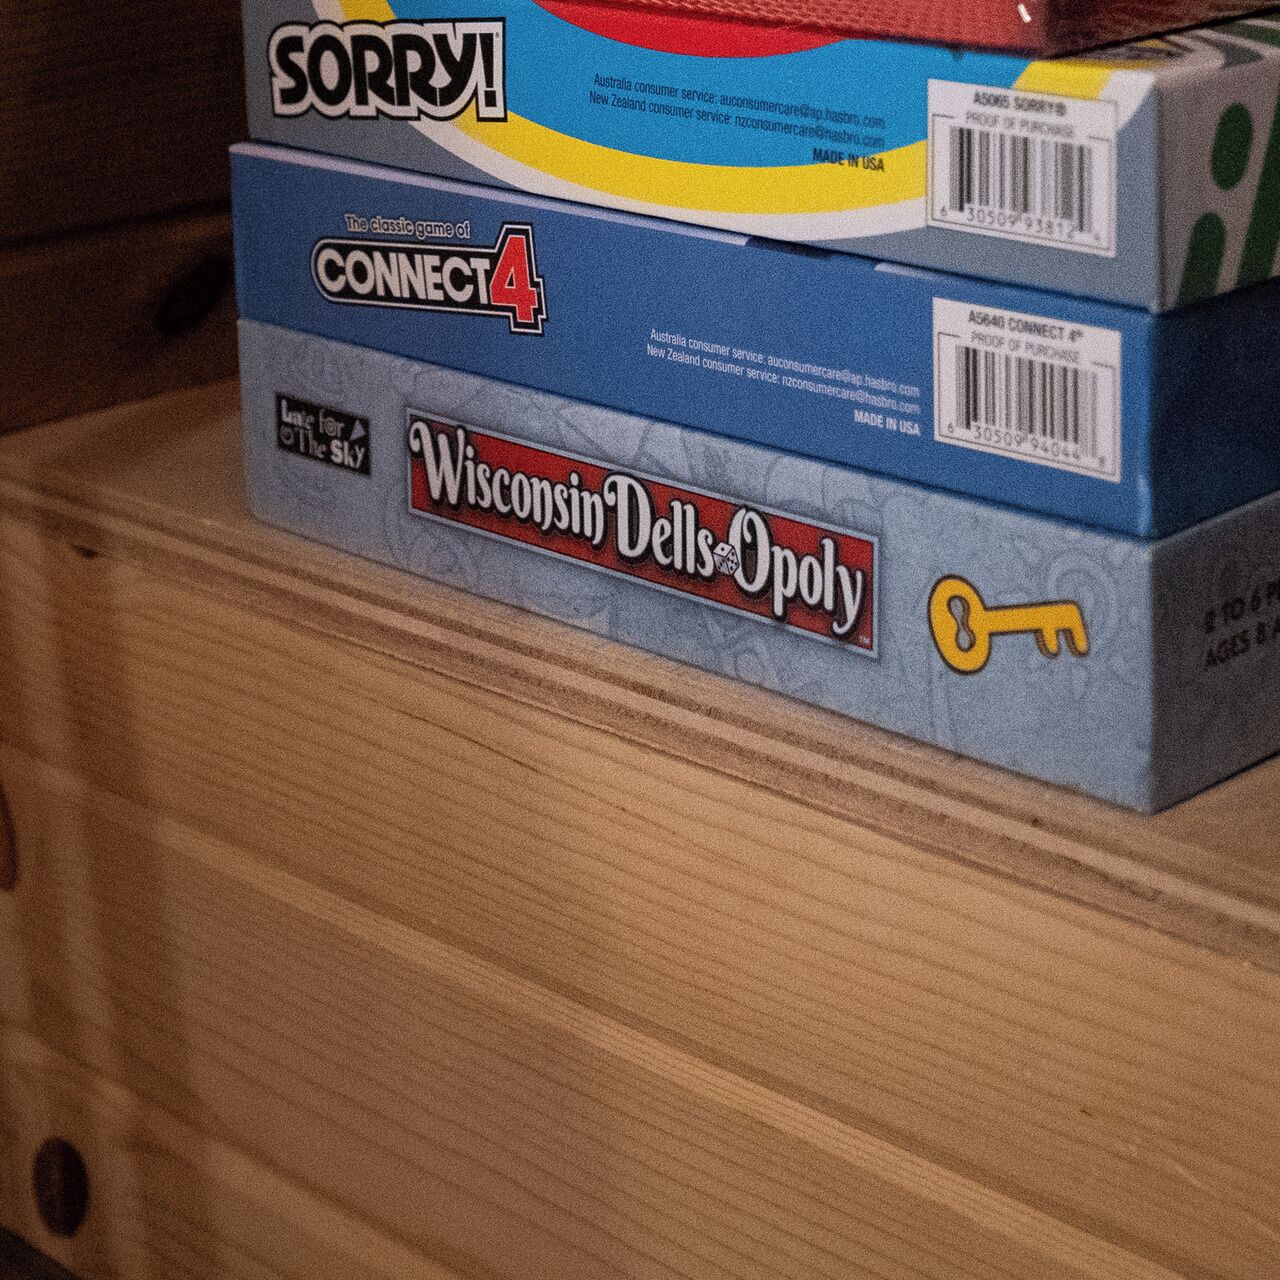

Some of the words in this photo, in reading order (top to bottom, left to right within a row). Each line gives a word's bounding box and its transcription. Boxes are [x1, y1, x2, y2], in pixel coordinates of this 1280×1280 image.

[273, 28, 500, 112] SORRY!
[593, 73, 632, 91] Australia
[634, 80, 679, 98] consumer
[589, 90, 609, 106] New
[611, 93, 646, 112] Zealand
[648, 100, 694, 120] consumer
[812, 147, 845, 166] MADE
[848, 153, 860, 169] IN
[862, 155, 885, 172] USA
[345, 213, 368, 233] The
[370, 216, 414, 235] classic
[416, 222, 454, 239] game
[455, 219, 470, 238] of
[317, 248, 491, 305] CONNECT
[489, 234, 539, 323] 4
[650, 328, 687, 347] Australia
[688, 338, 731, 357] consumer
[971, 331, 1005, 349] PROOF
[1008, 338, 1021, 352] OF
[1008, 317, 1065, 342] CONNECT
[647, 343, 666, 359] New
[667, 348, 701, 367] Zealand
[702, 358, 745, 376] consumer
[746, 367, 780, 384] service:
[854, 409, 883, 428] MADE
[885, 416, 898, 431] IN
[899, 419, 921, 437] USA
[408, 420, 605, 547] Wisconsin
[602, 473, 717, 579] Dells
[727, 505, 865, 637] Opoly
[1205, 629, 1250, 671] AGES
